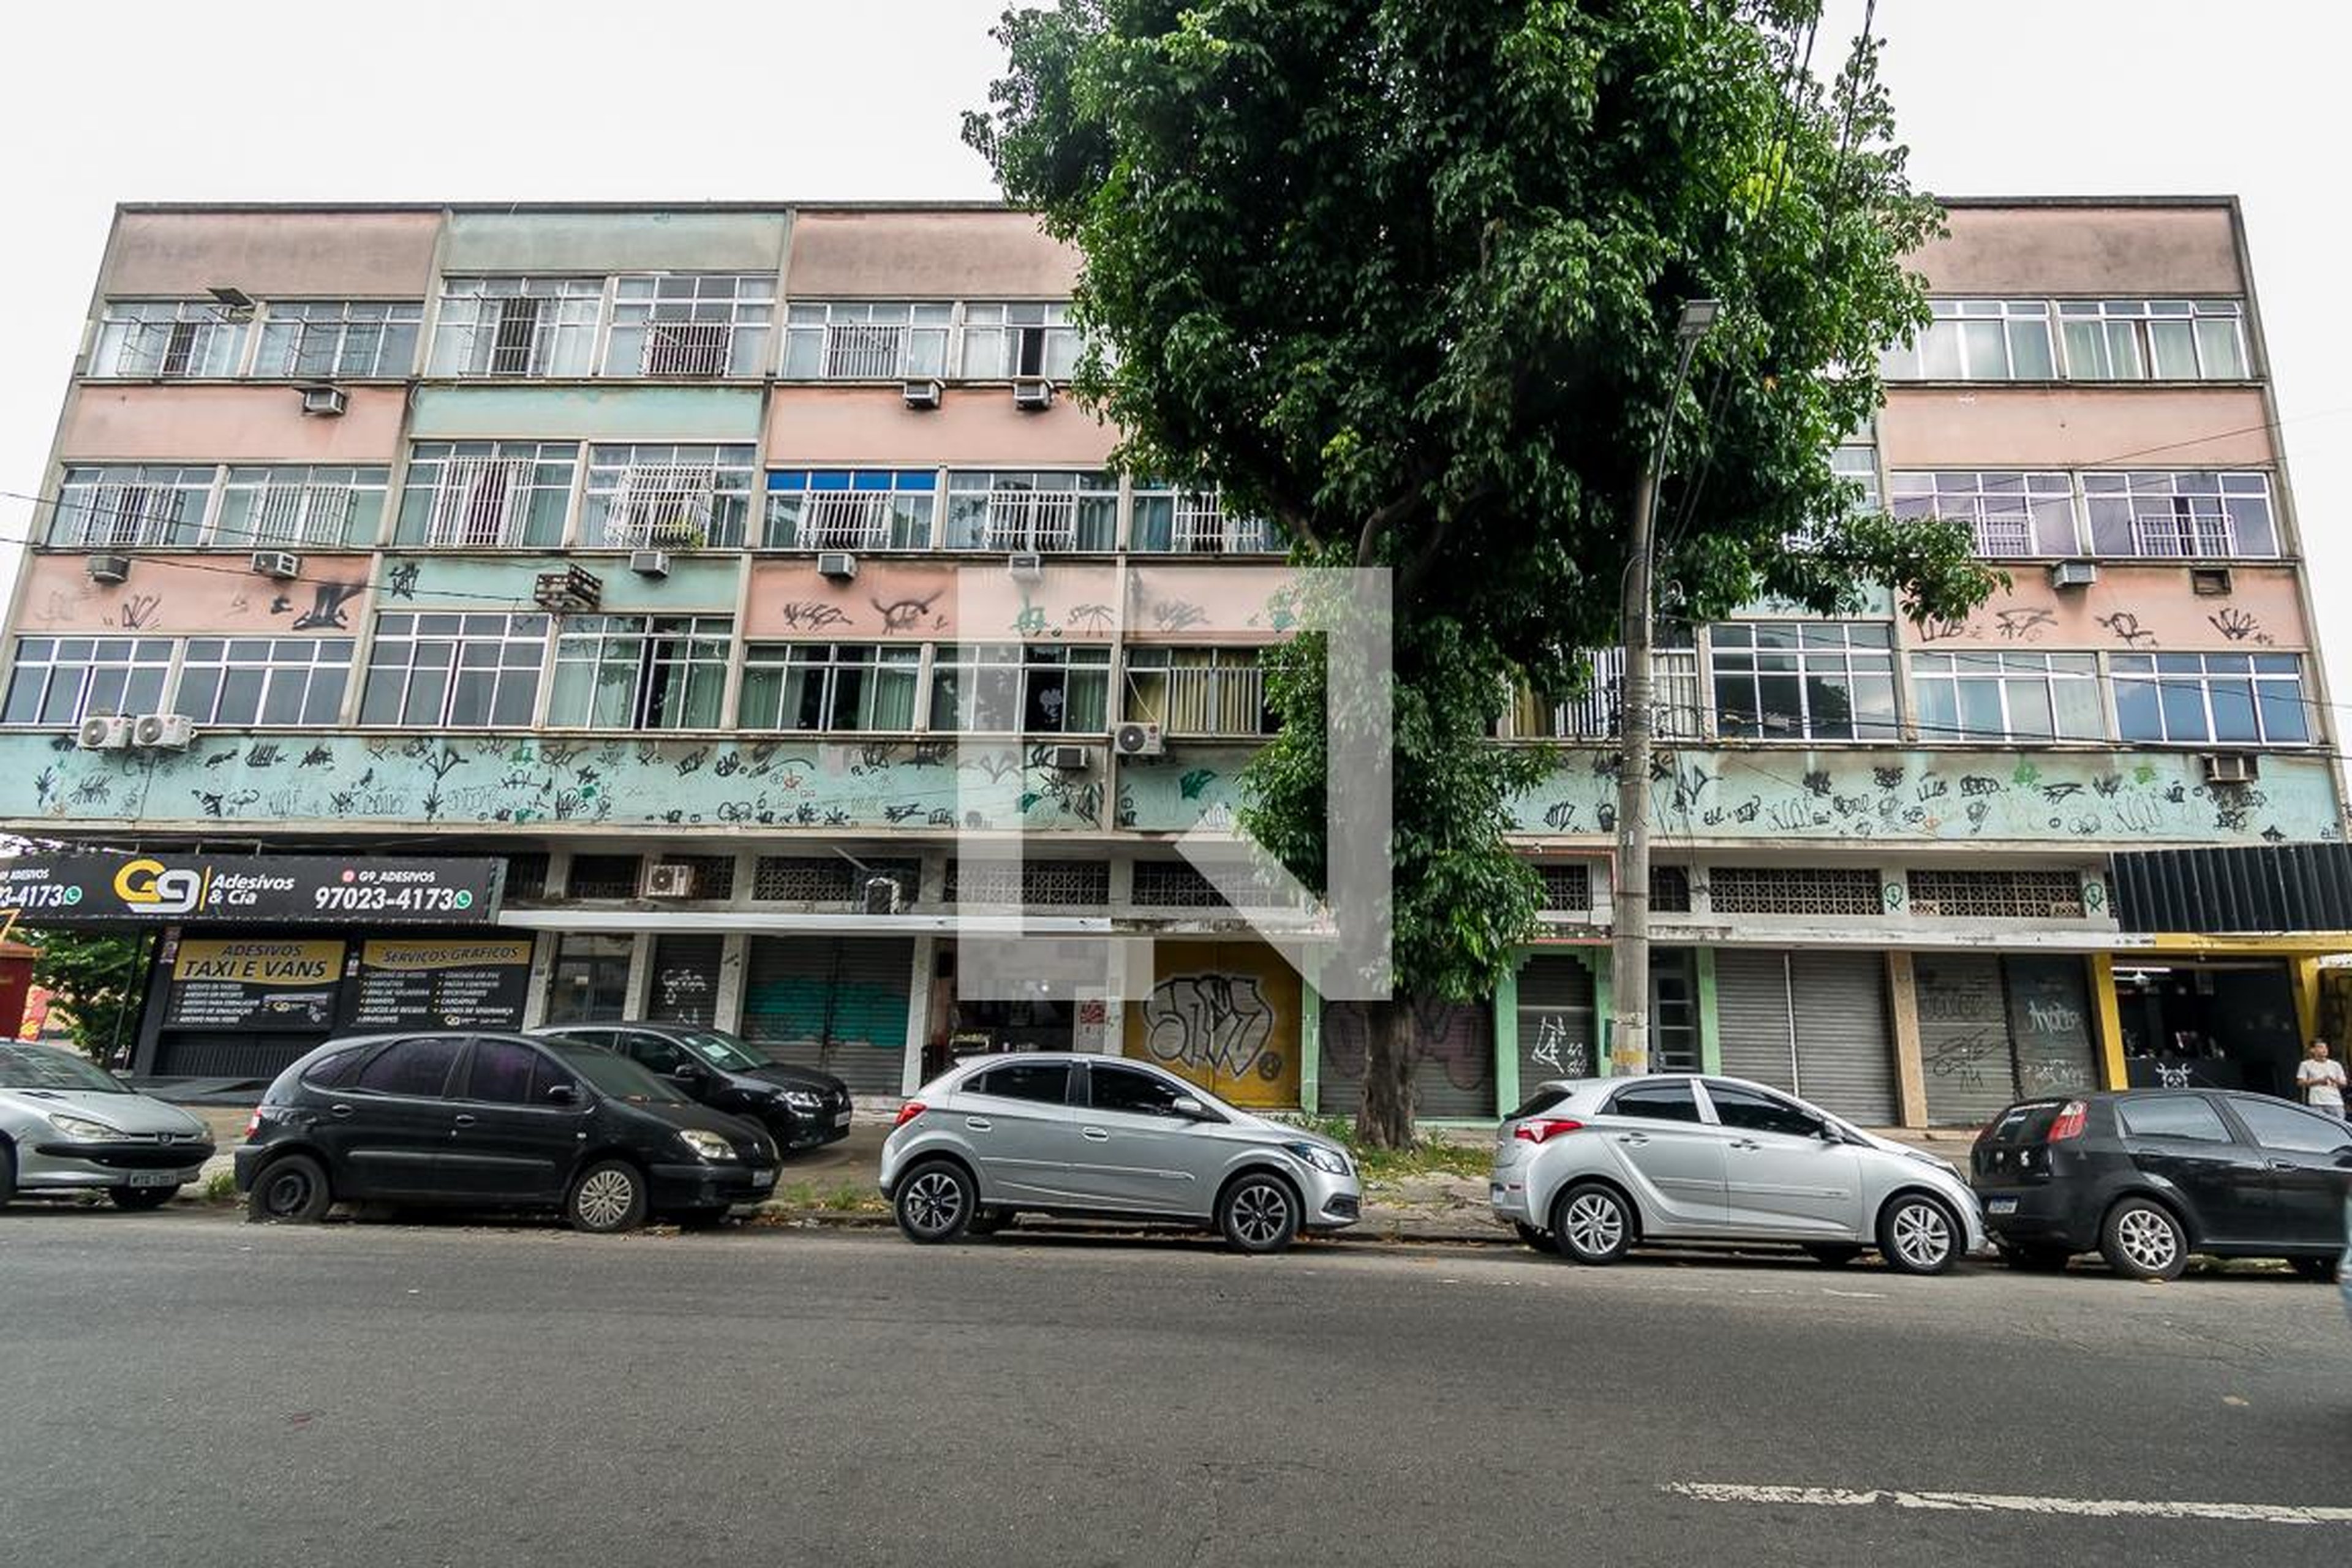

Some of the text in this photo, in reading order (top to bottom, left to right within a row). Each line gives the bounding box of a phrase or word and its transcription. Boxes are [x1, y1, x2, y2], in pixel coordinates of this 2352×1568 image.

[210, 873, 295, 890] Adesivos
[358, 870, 435, 884] G9_ADESIVOS
[0, 884, 64, 907] 3-4173
[208, 889, 257, 905] & Cia
[315, 887, 454, 910] 97023-4173
[221, 944, 303, 956] ADESIVOS
[183, 961, 327, 978] TAXI E VANS
